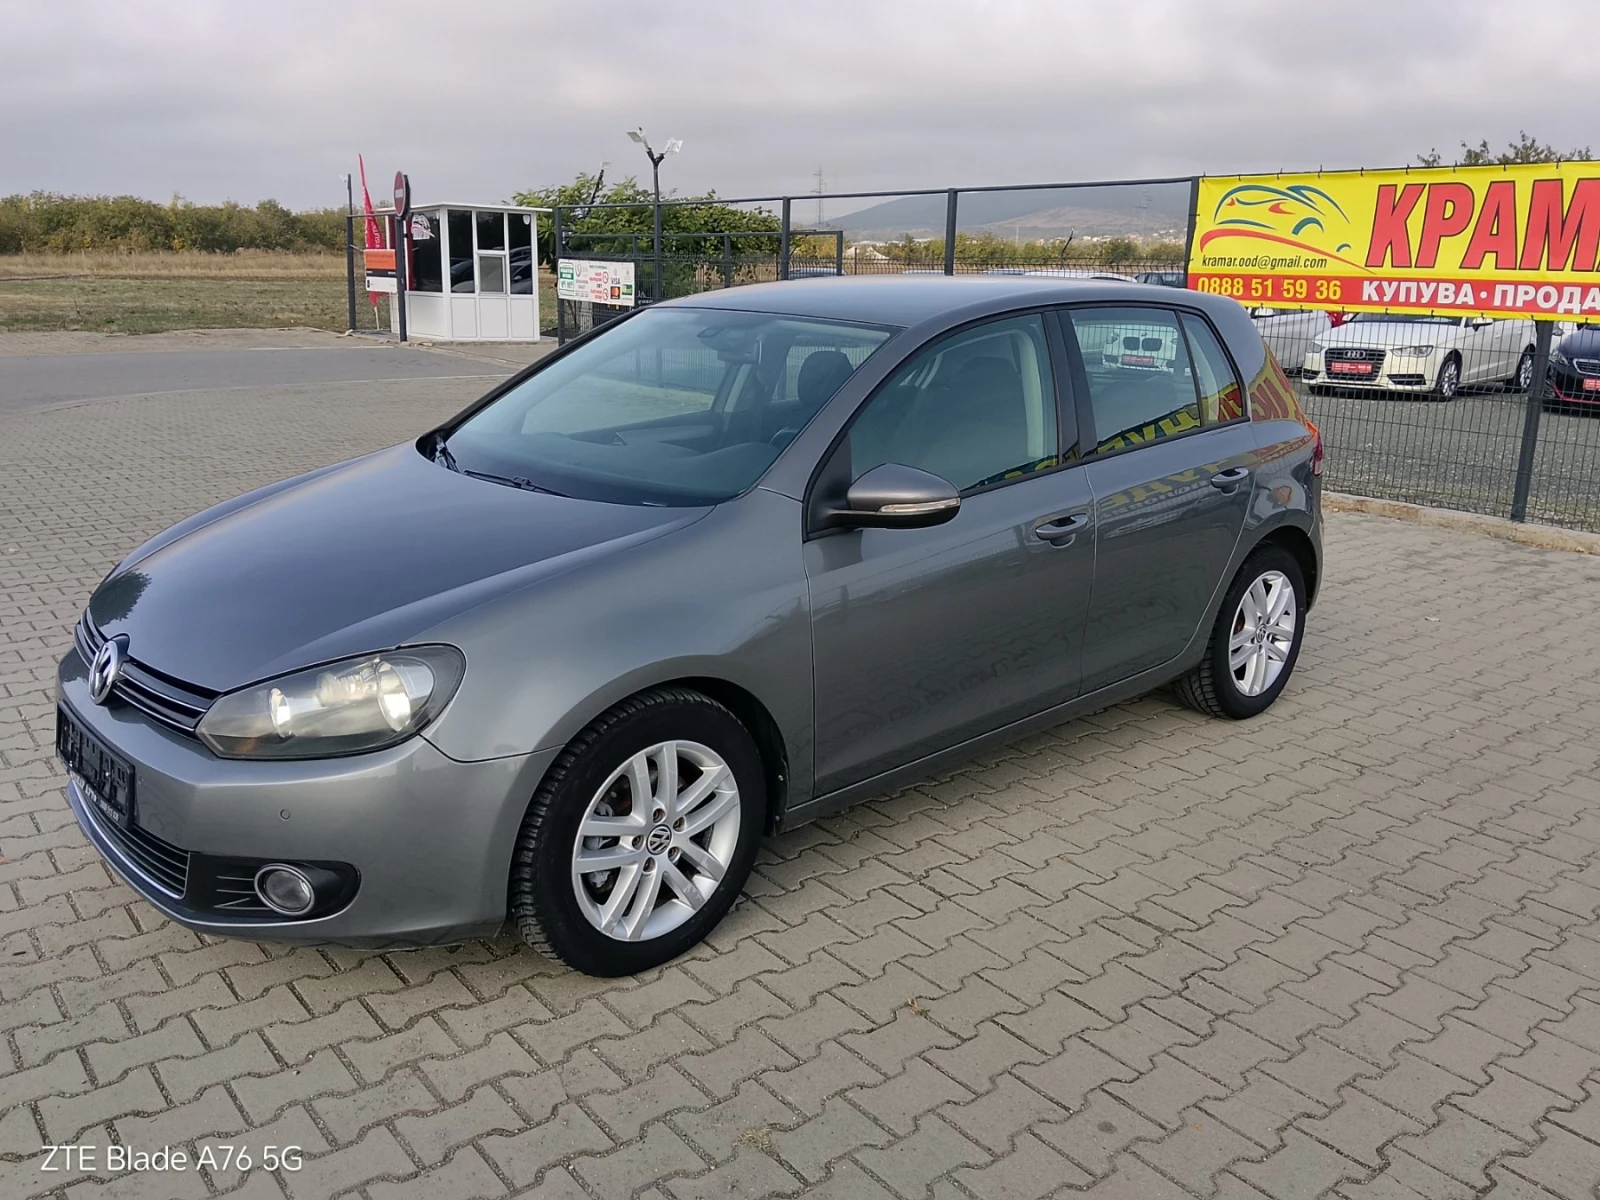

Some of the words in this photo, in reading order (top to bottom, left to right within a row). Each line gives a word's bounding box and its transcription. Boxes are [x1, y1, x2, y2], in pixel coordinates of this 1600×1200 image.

[1365, 178, 1600, 272] КРАМ
[1202, 255, 1328, 270] kramar.ood@gmail.com
[1197, 277, 1244, 297] 0888
[1251, 278, 1273, 297] 51
[1282, 279, 1307, 299] 59
[1315, 280, 1341, 300] 36
[1362, 280, 1475, 305] КУПУВА
[1493, 284, 1600, 315] ПРОДА
